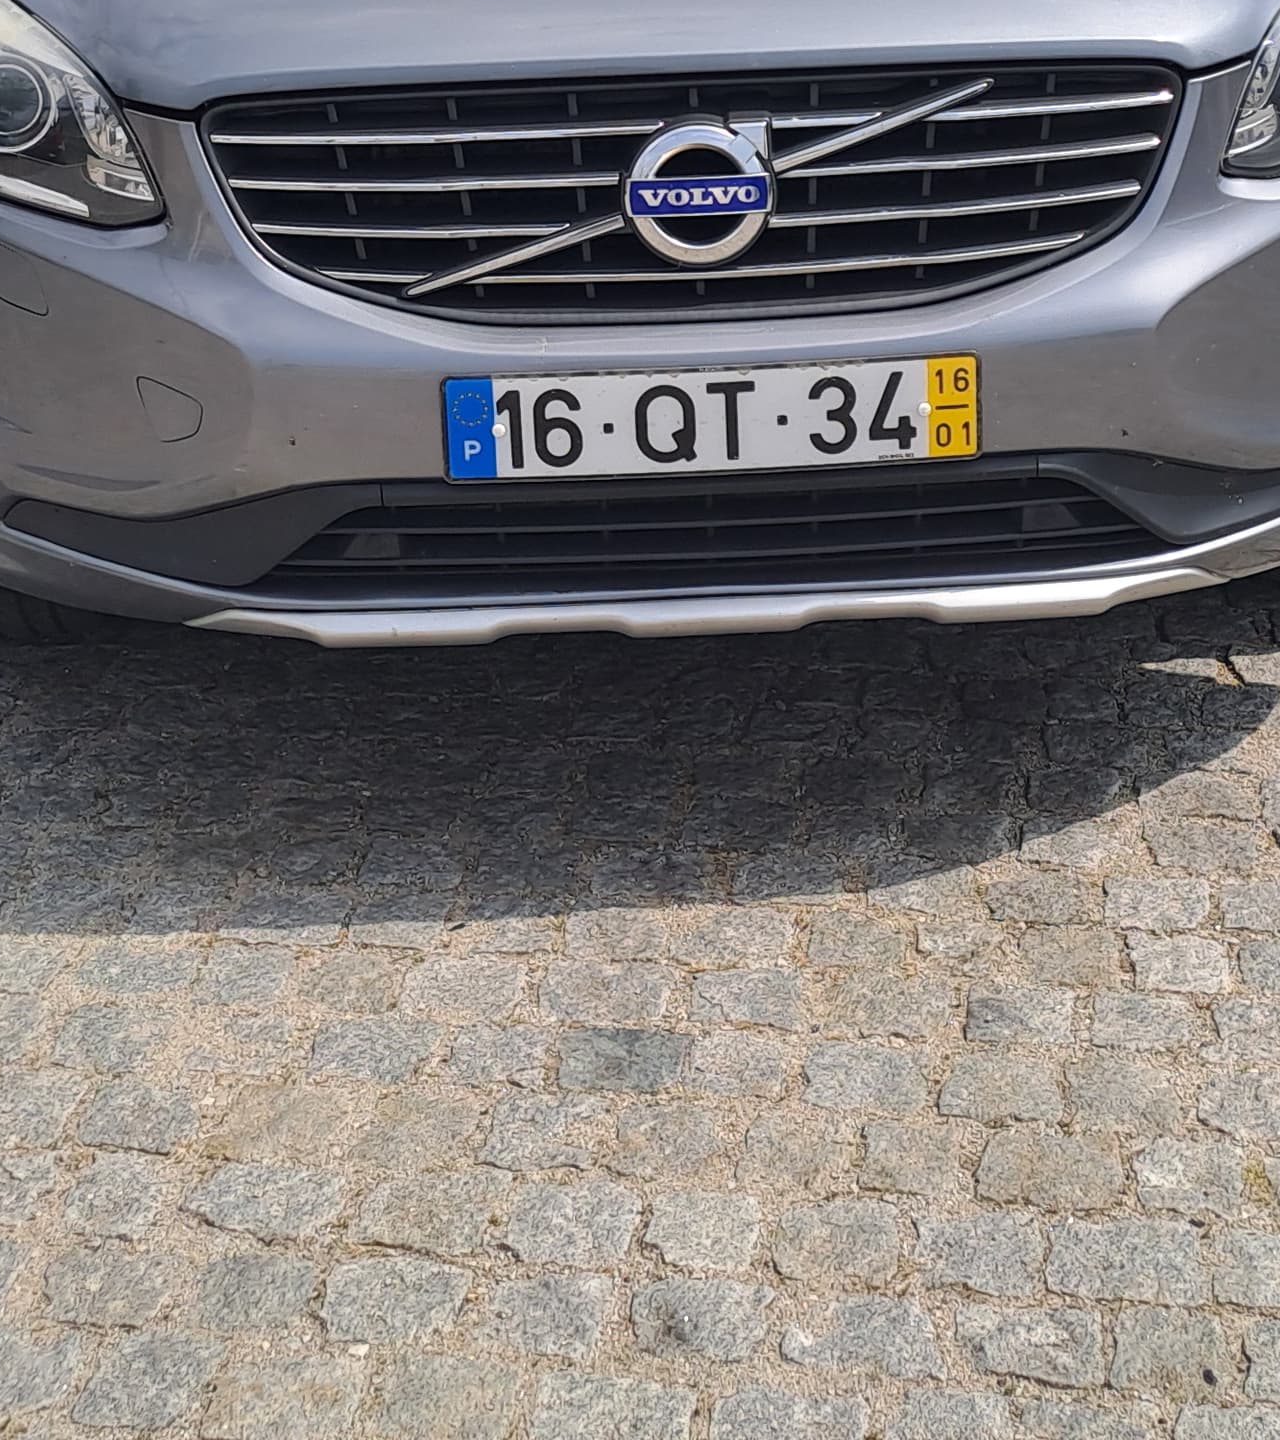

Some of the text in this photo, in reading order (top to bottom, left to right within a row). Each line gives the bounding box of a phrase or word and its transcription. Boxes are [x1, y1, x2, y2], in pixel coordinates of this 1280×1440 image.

[637, 184, 760, 208] VOLVO
[934, 367, 970, 395] 16
[934, 420, 972, 448] 01
[464, 439, 482, 460] P
